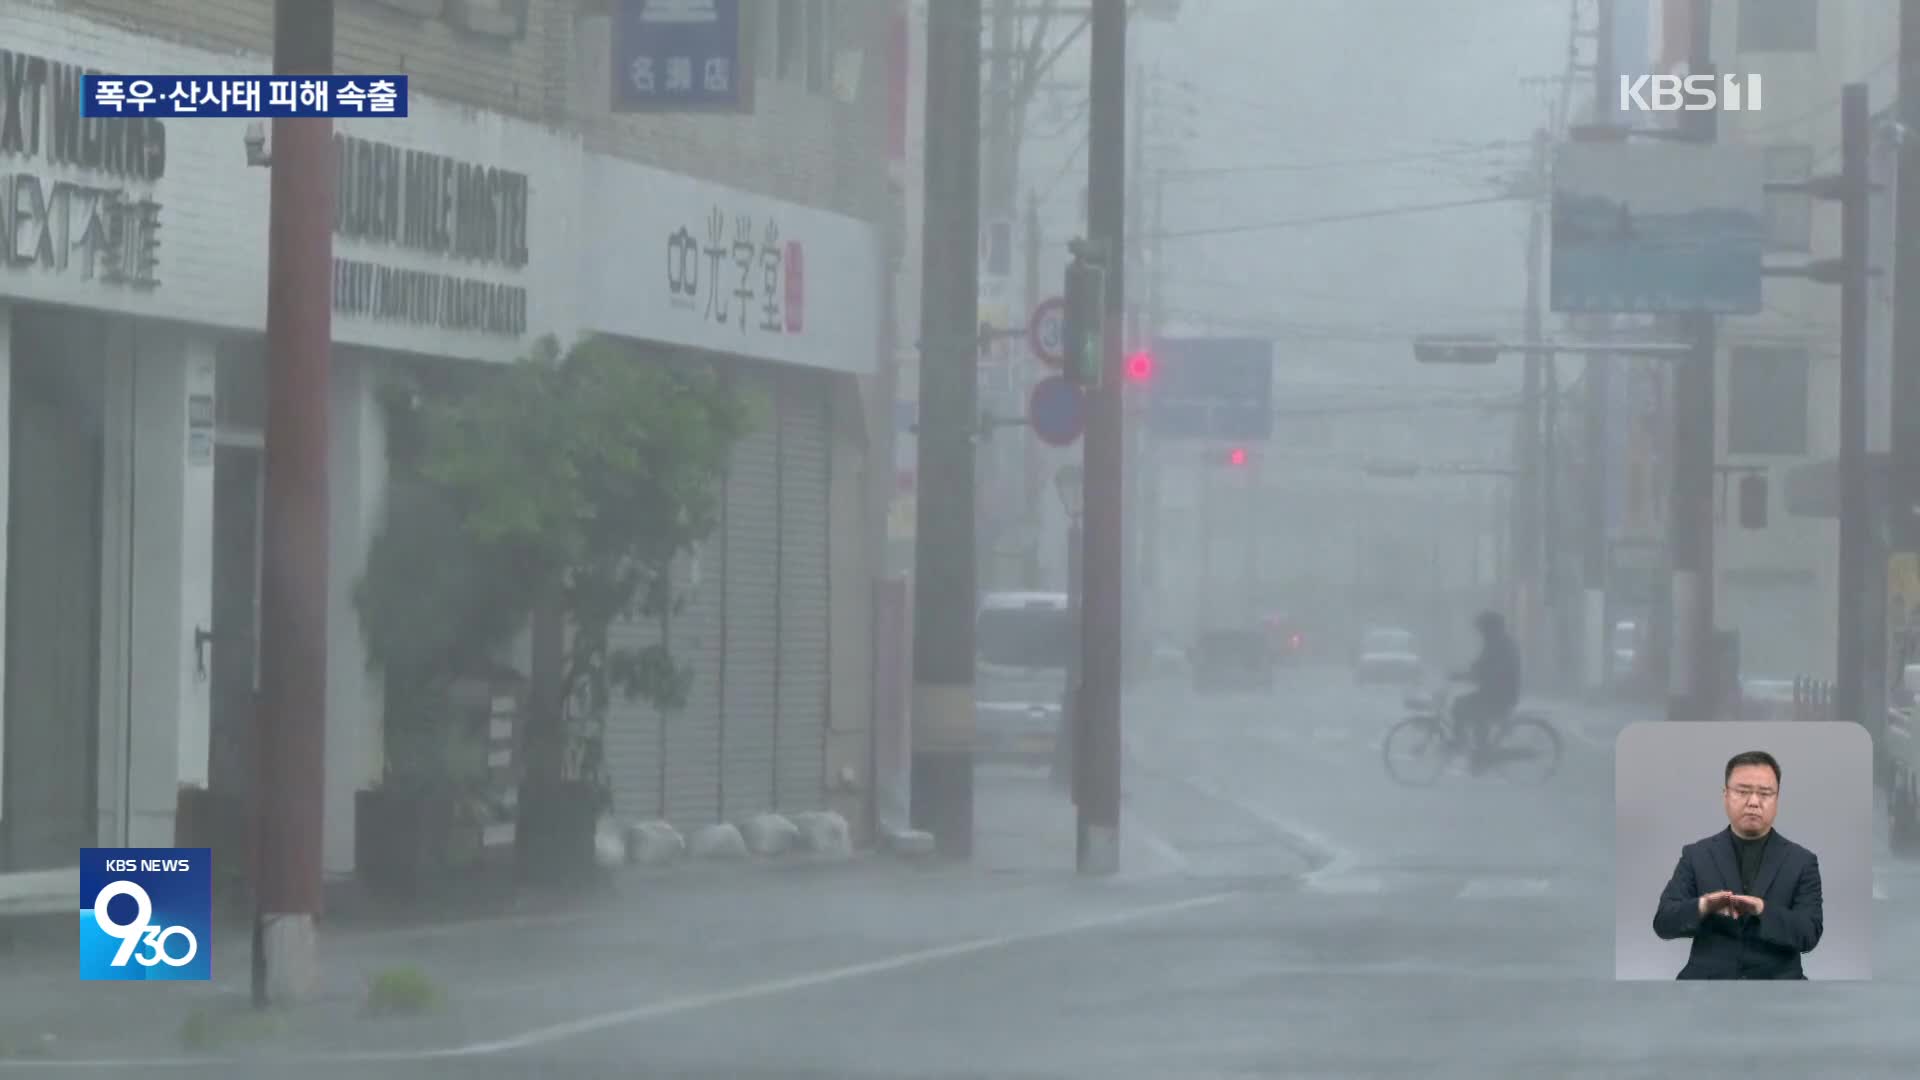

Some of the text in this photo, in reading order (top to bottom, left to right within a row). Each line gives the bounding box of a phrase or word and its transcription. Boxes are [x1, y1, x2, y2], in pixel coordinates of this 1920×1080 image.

[0, 48, 48, 158] XT
[333, 131, 528, 266] OLDEN MILE HOSTEL
